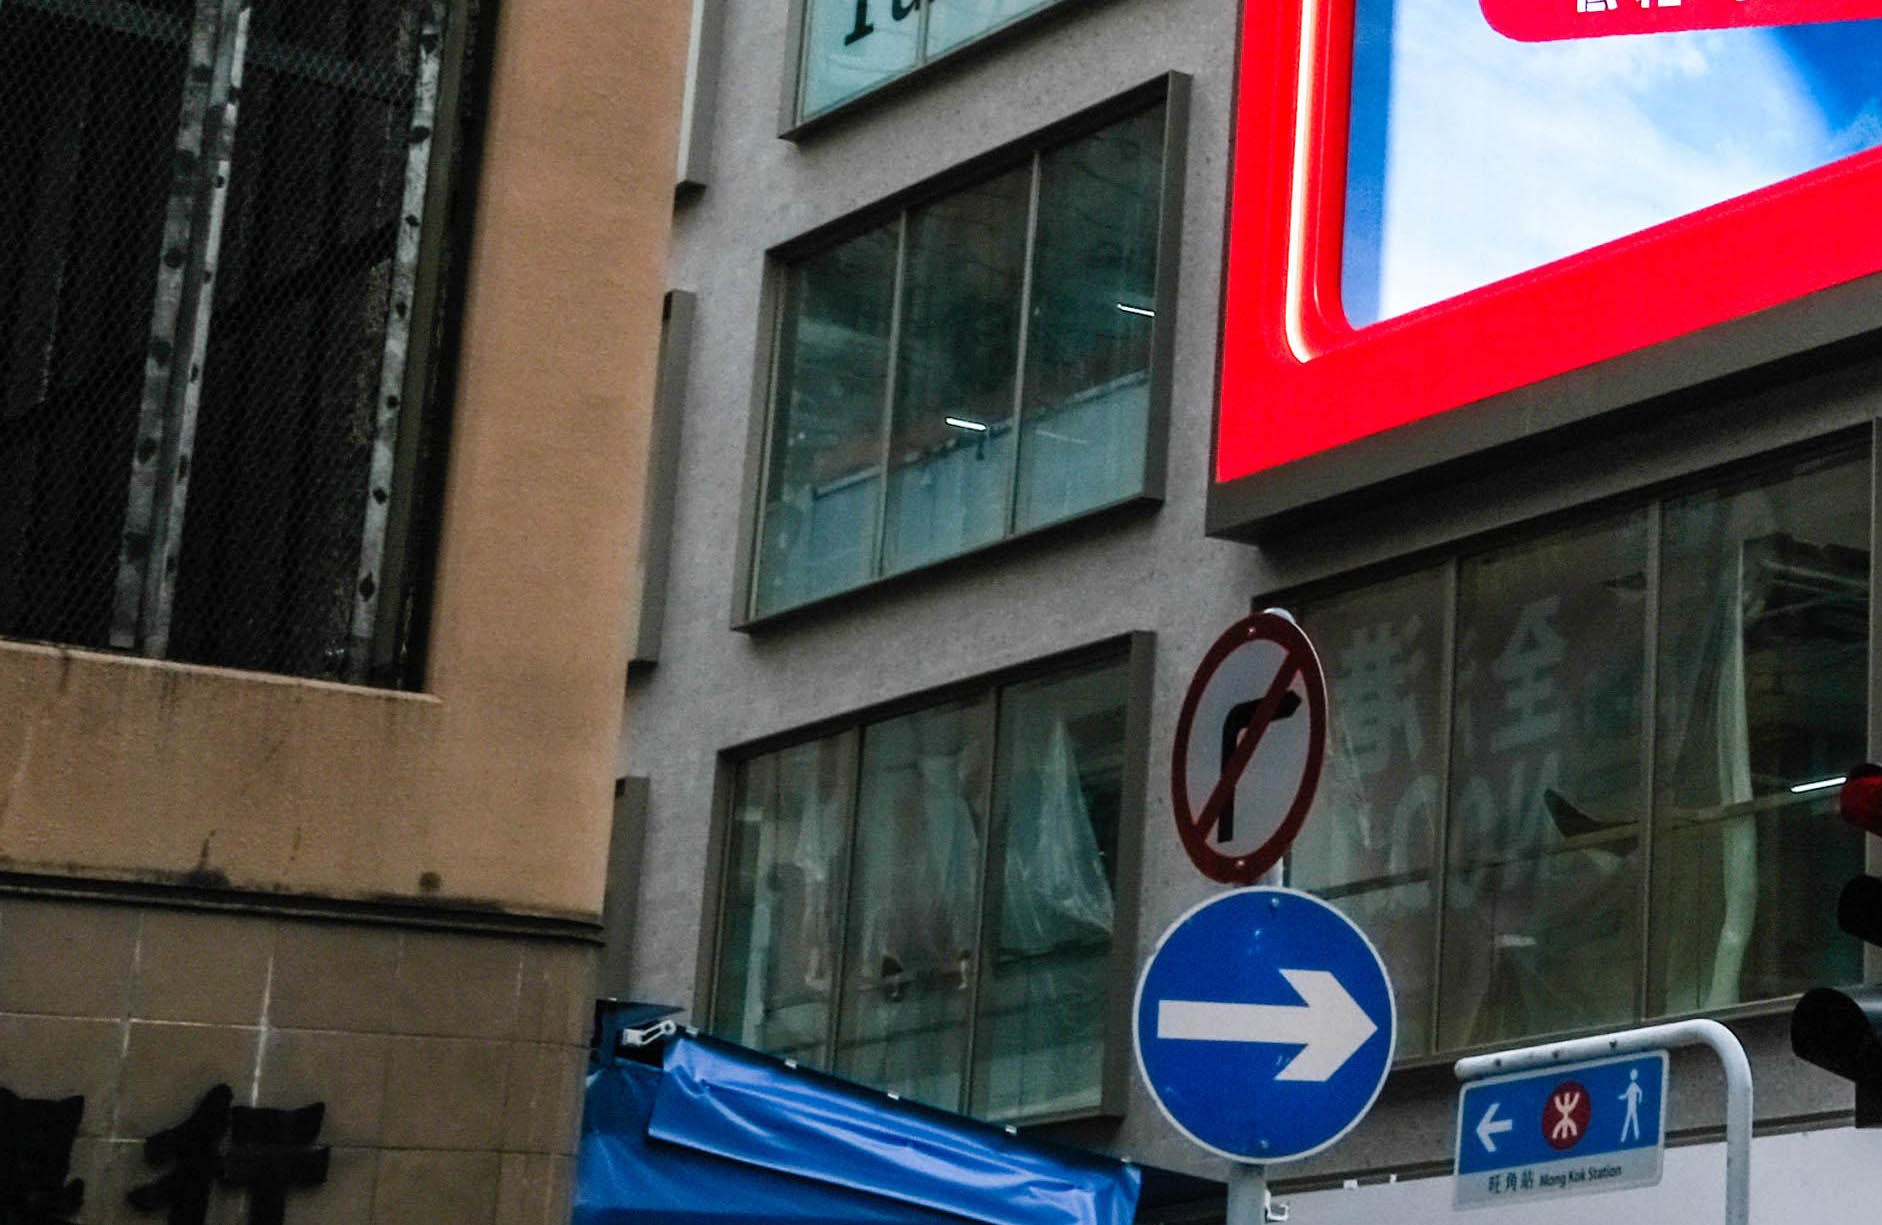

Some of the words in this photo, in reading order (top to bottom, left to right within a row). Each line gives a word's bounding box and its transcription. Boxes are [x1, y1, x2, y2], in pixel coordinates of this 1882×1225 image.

[1488, 1168, 1534, 1194] 旺角站
[1588, 1165, 1623, 1181] Station
